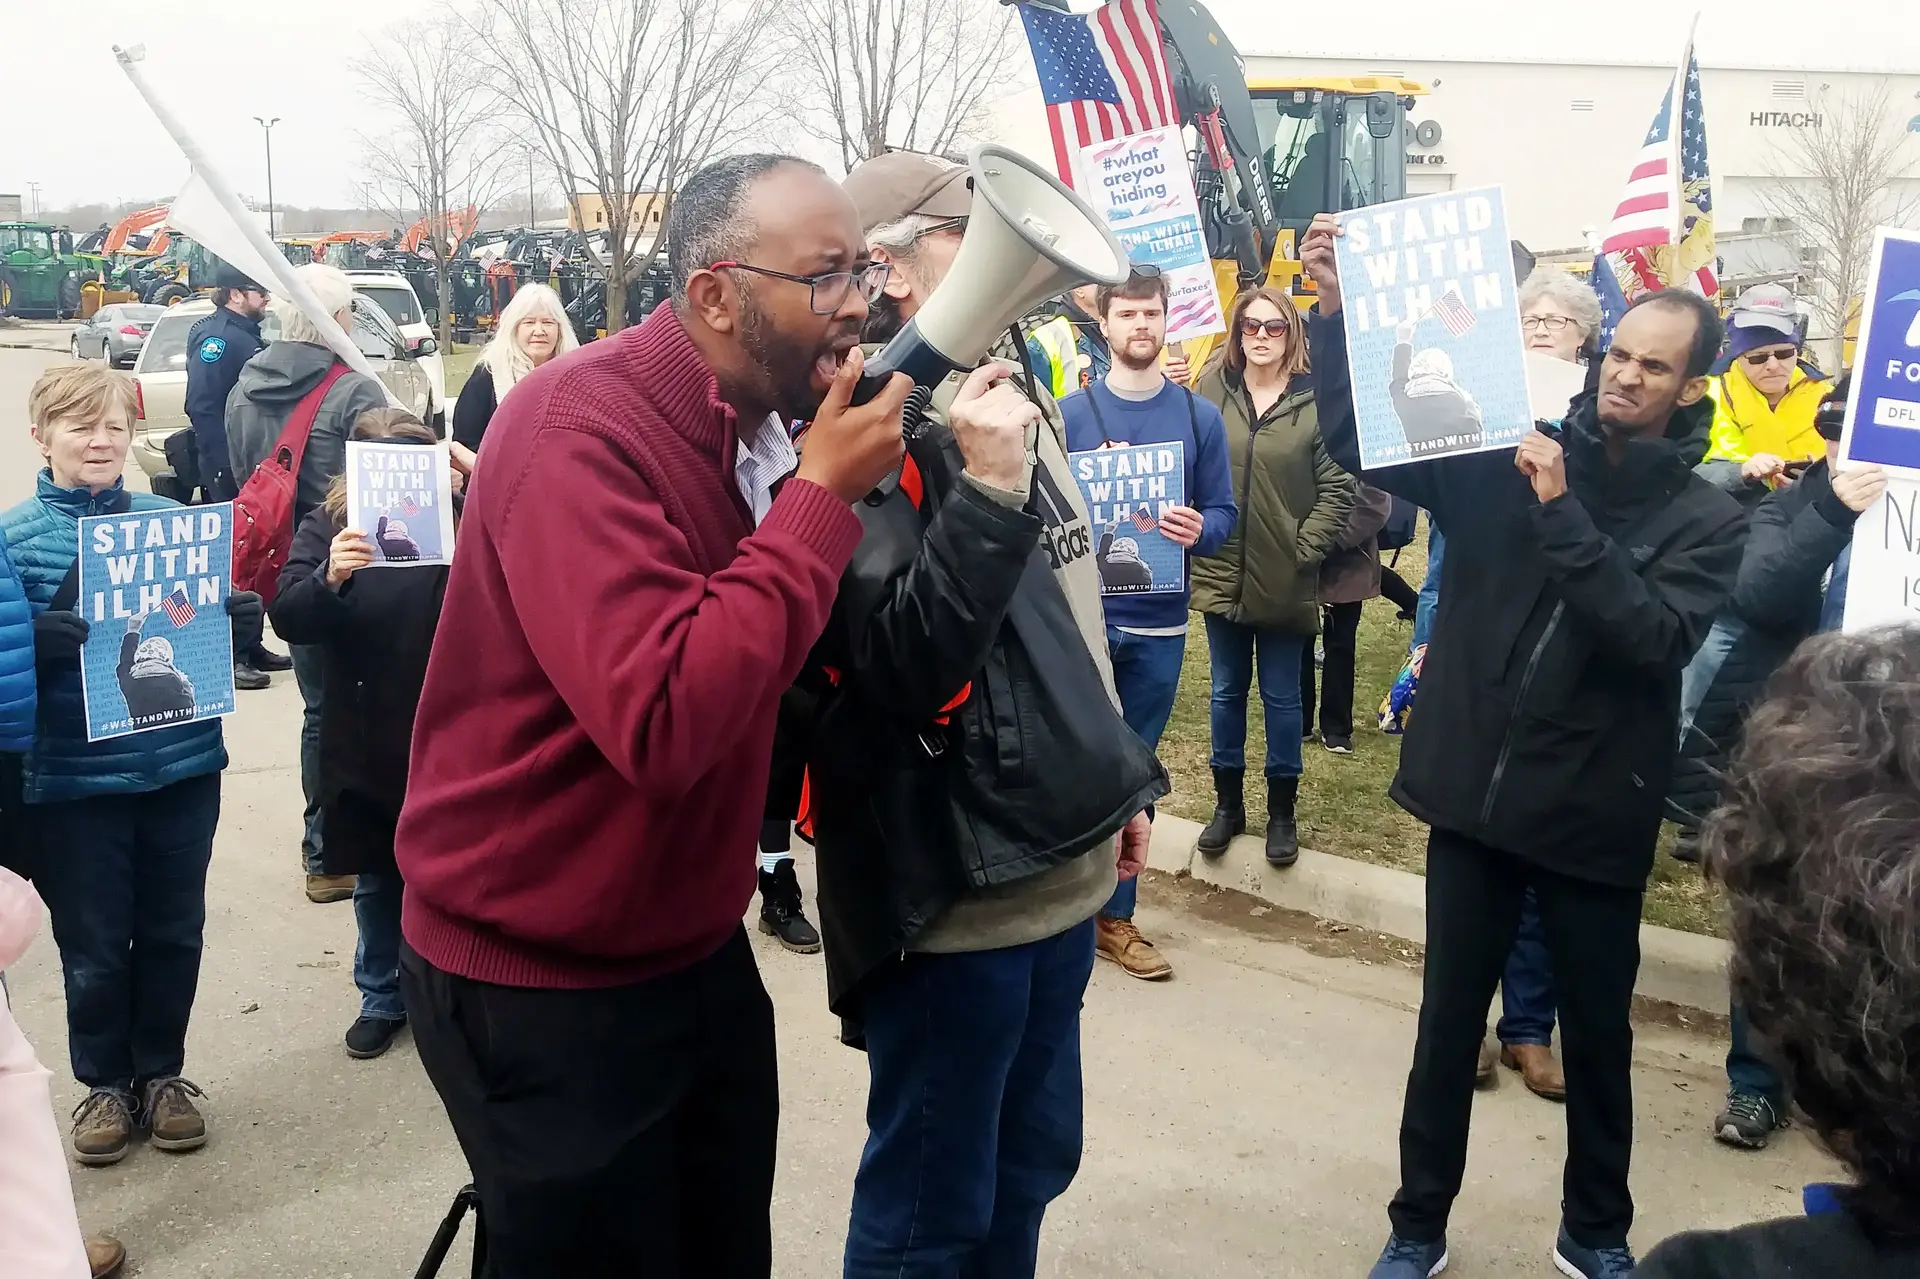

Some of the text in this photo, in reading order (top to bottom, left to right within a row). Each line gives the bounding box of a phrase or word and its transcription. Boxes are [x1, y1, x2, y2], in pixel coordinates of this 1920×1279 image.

[1750, 111, 1822, 127] HITACHI
[1103, 146, 1159, 171] #what
[1103, 162, 1165, 187] areyou
[1110, 183, 1167, 206] hiding
[1248, 156, 1273, 226] DEERE
[1154, 220, 1191, 240] WITH
[1346, 196, 1492, 253] STAND
[1148, 233, 1194, 253] ILHAN
[1364, 236, 1483, 289] WITH
[1888, 407, 1916, 421] DFL
[362, 452, 430, 471] STAND
[1078, 449, 1174, 481] STAND
[369, 471, 425, 489] WITH
[1088, 476, 1166, 503] WITH
[93, 512, 222, 554] STAND
[106, 545, 209, 585] WITH
